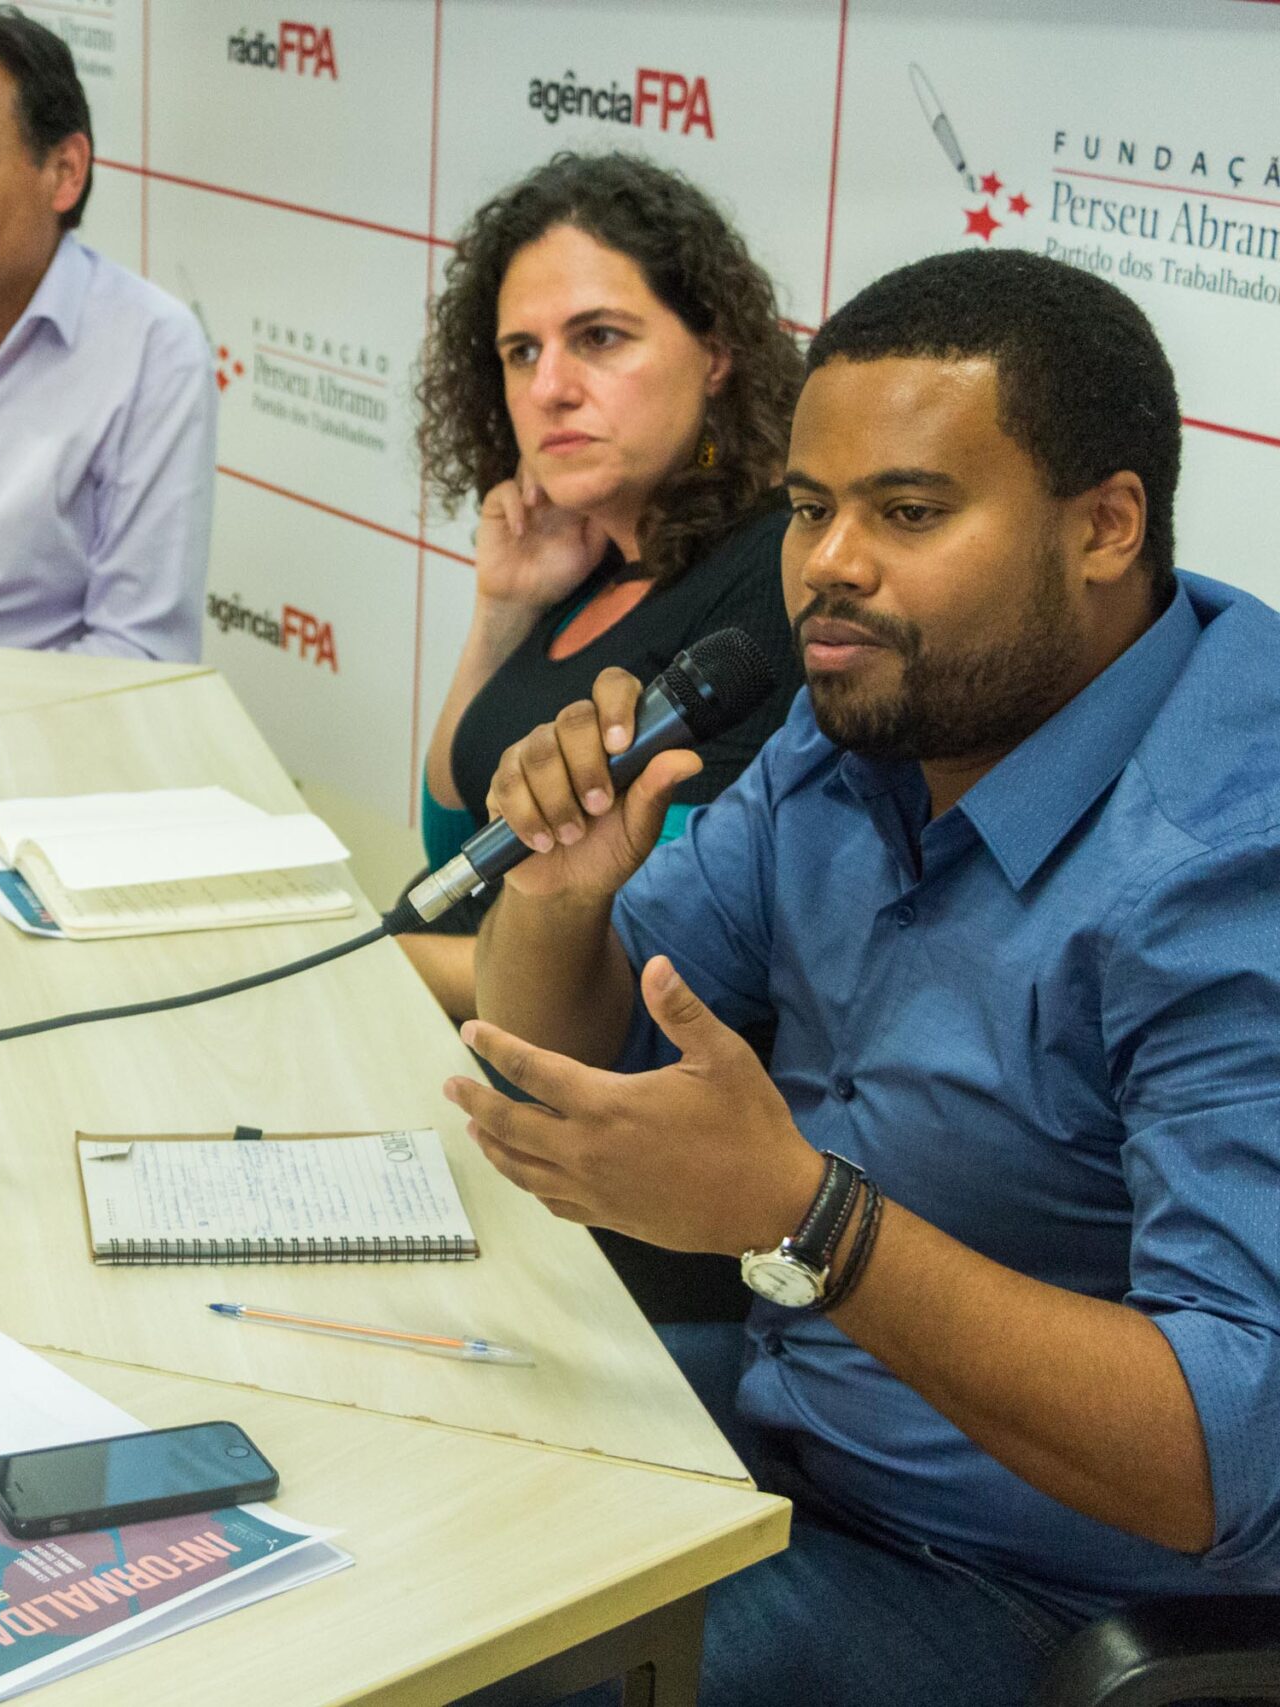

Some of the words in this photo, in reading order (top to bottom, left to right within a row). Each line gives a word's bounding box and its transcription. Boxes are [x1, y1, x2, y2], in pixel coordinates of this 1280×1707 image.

[1050, 180, 1159, 240] Perseu
[1046, 237, 1112, 272] Partido
[1119, 251, 1153, 281] dos
